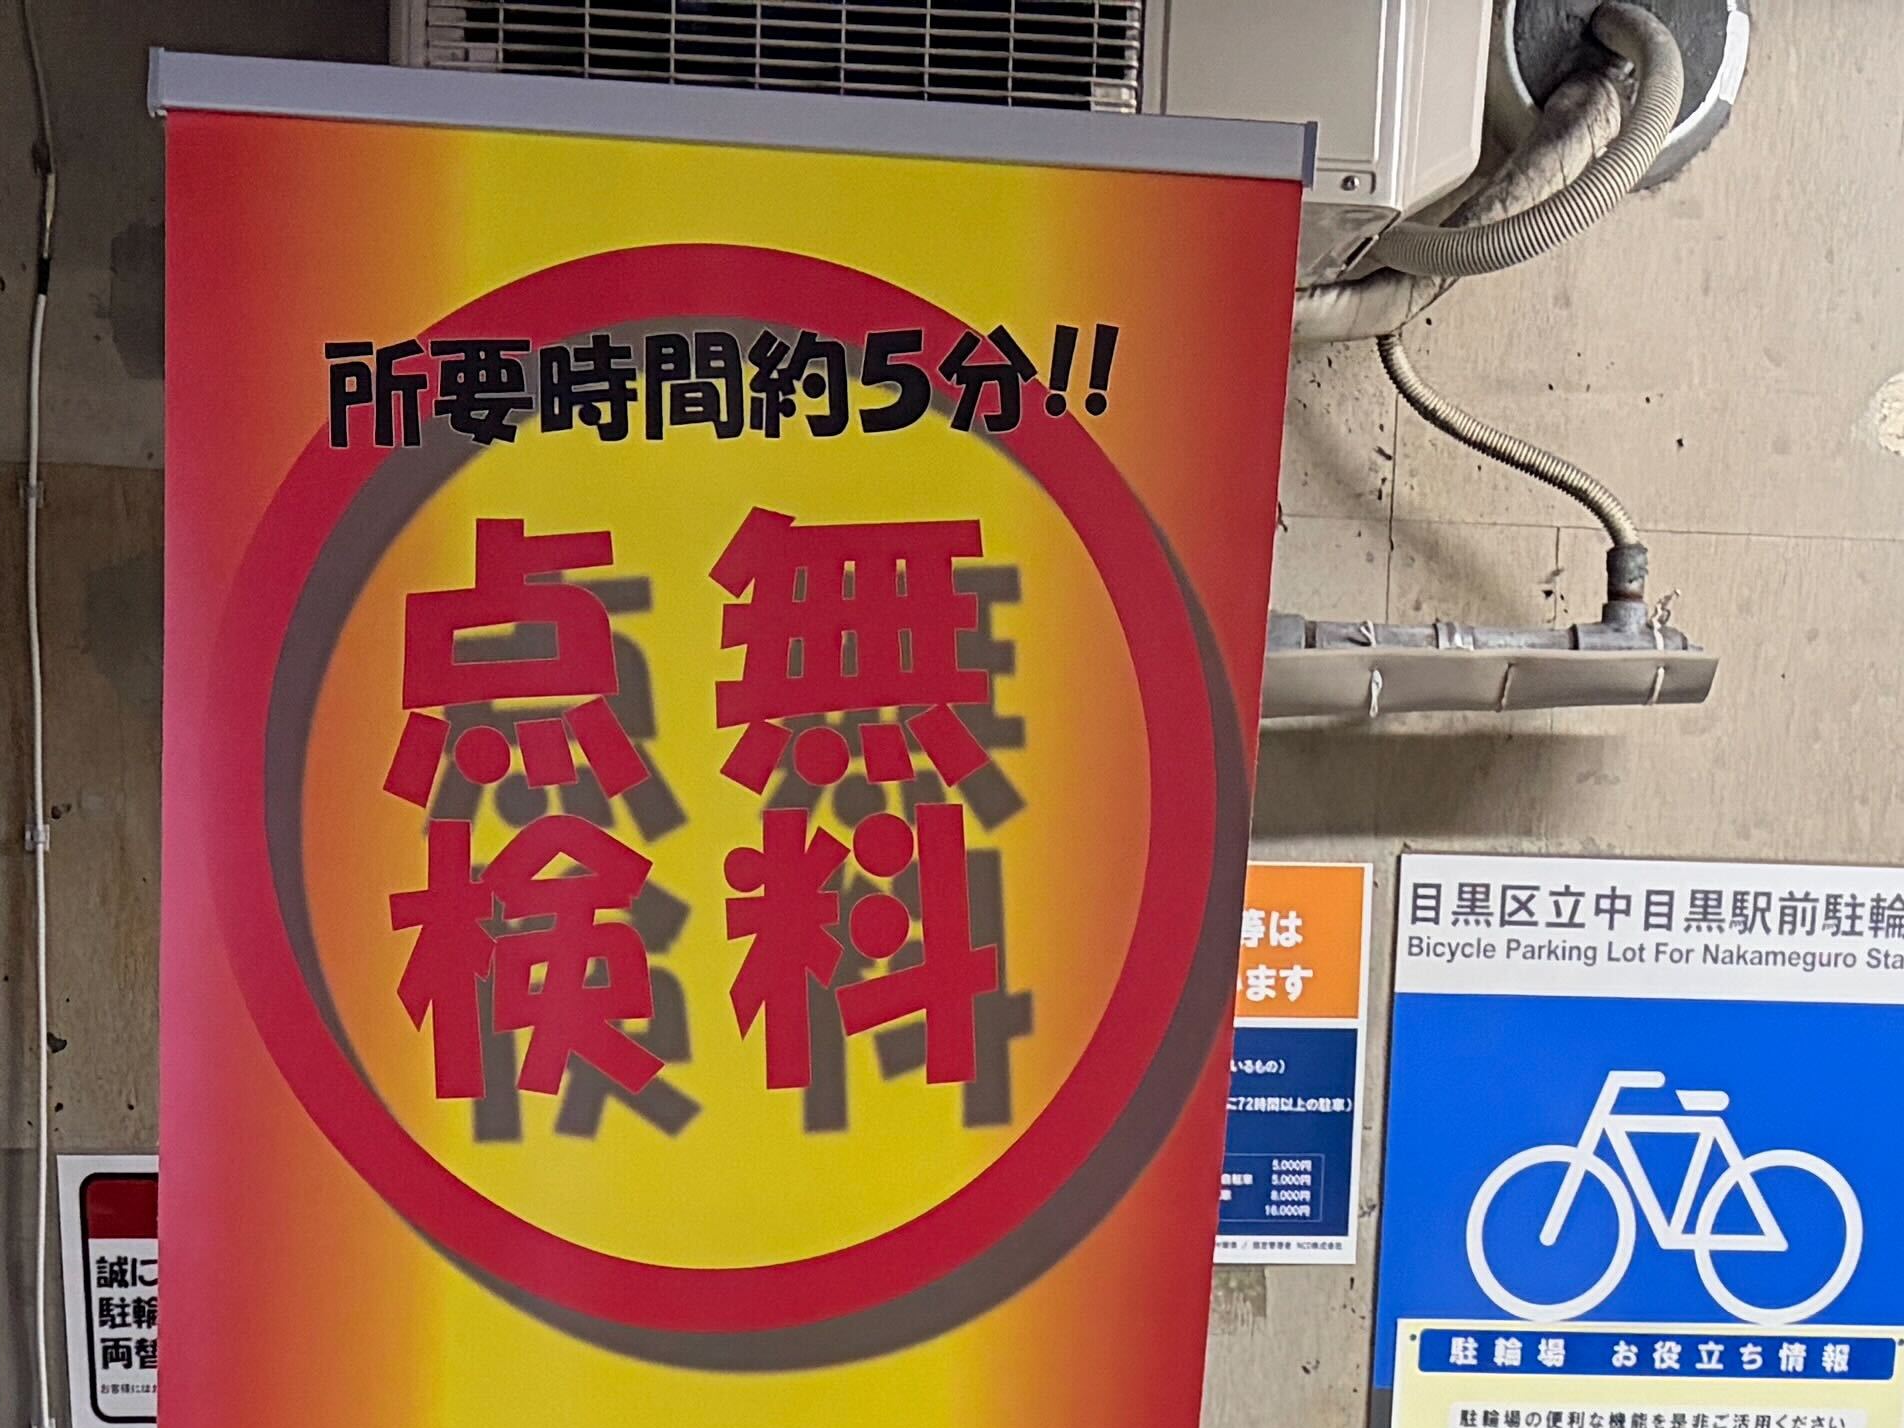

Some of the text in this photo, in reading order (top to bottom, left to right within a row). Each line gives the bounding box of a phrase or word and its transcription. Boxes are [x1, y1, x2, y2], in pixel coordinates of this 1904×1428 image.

[323, 322, 1122, 450] 所要時間約5分!!
[381, 516, 668, 1102] 点検
[708, 503, 1006, 1092] 無料
[1408, 935, 1496, 962] Bicycle
[1505, 938, 1599, 969] Parking
[1607, 941, 1646, 965] Lot
[1653, 942, 1694, 966] For
[1702, 943, 1857, 971] Nakameguro
[96, 1256, 158, 1289] 誠に
[1449, 1336, 1853, 1374] 駐輪場 お役立ち情報
